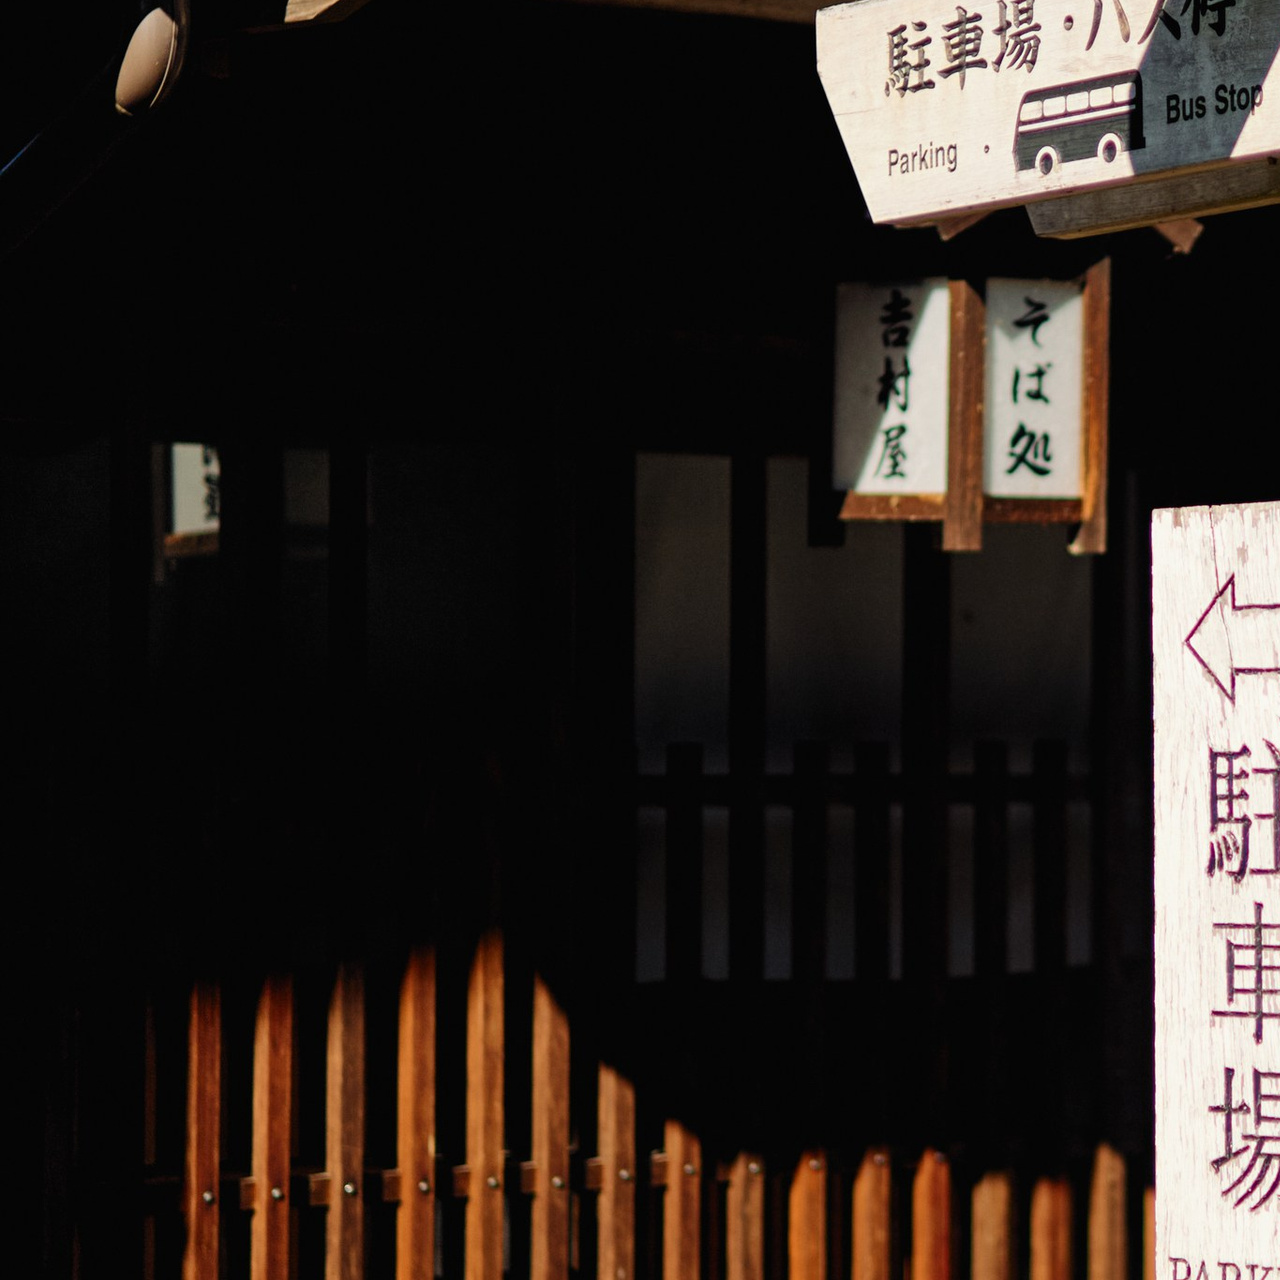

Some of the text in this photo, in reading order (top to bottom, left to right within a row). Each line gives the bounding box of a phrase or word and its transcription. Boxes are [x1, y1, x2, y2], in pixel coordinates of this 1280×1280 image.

[887, 141, 959, 177] Parking
[1165, 82, 1264, 124] Bus Stop
[874, 288, 913, 479] 吉村屋
[1005, 295, 1054, 477] そば処
